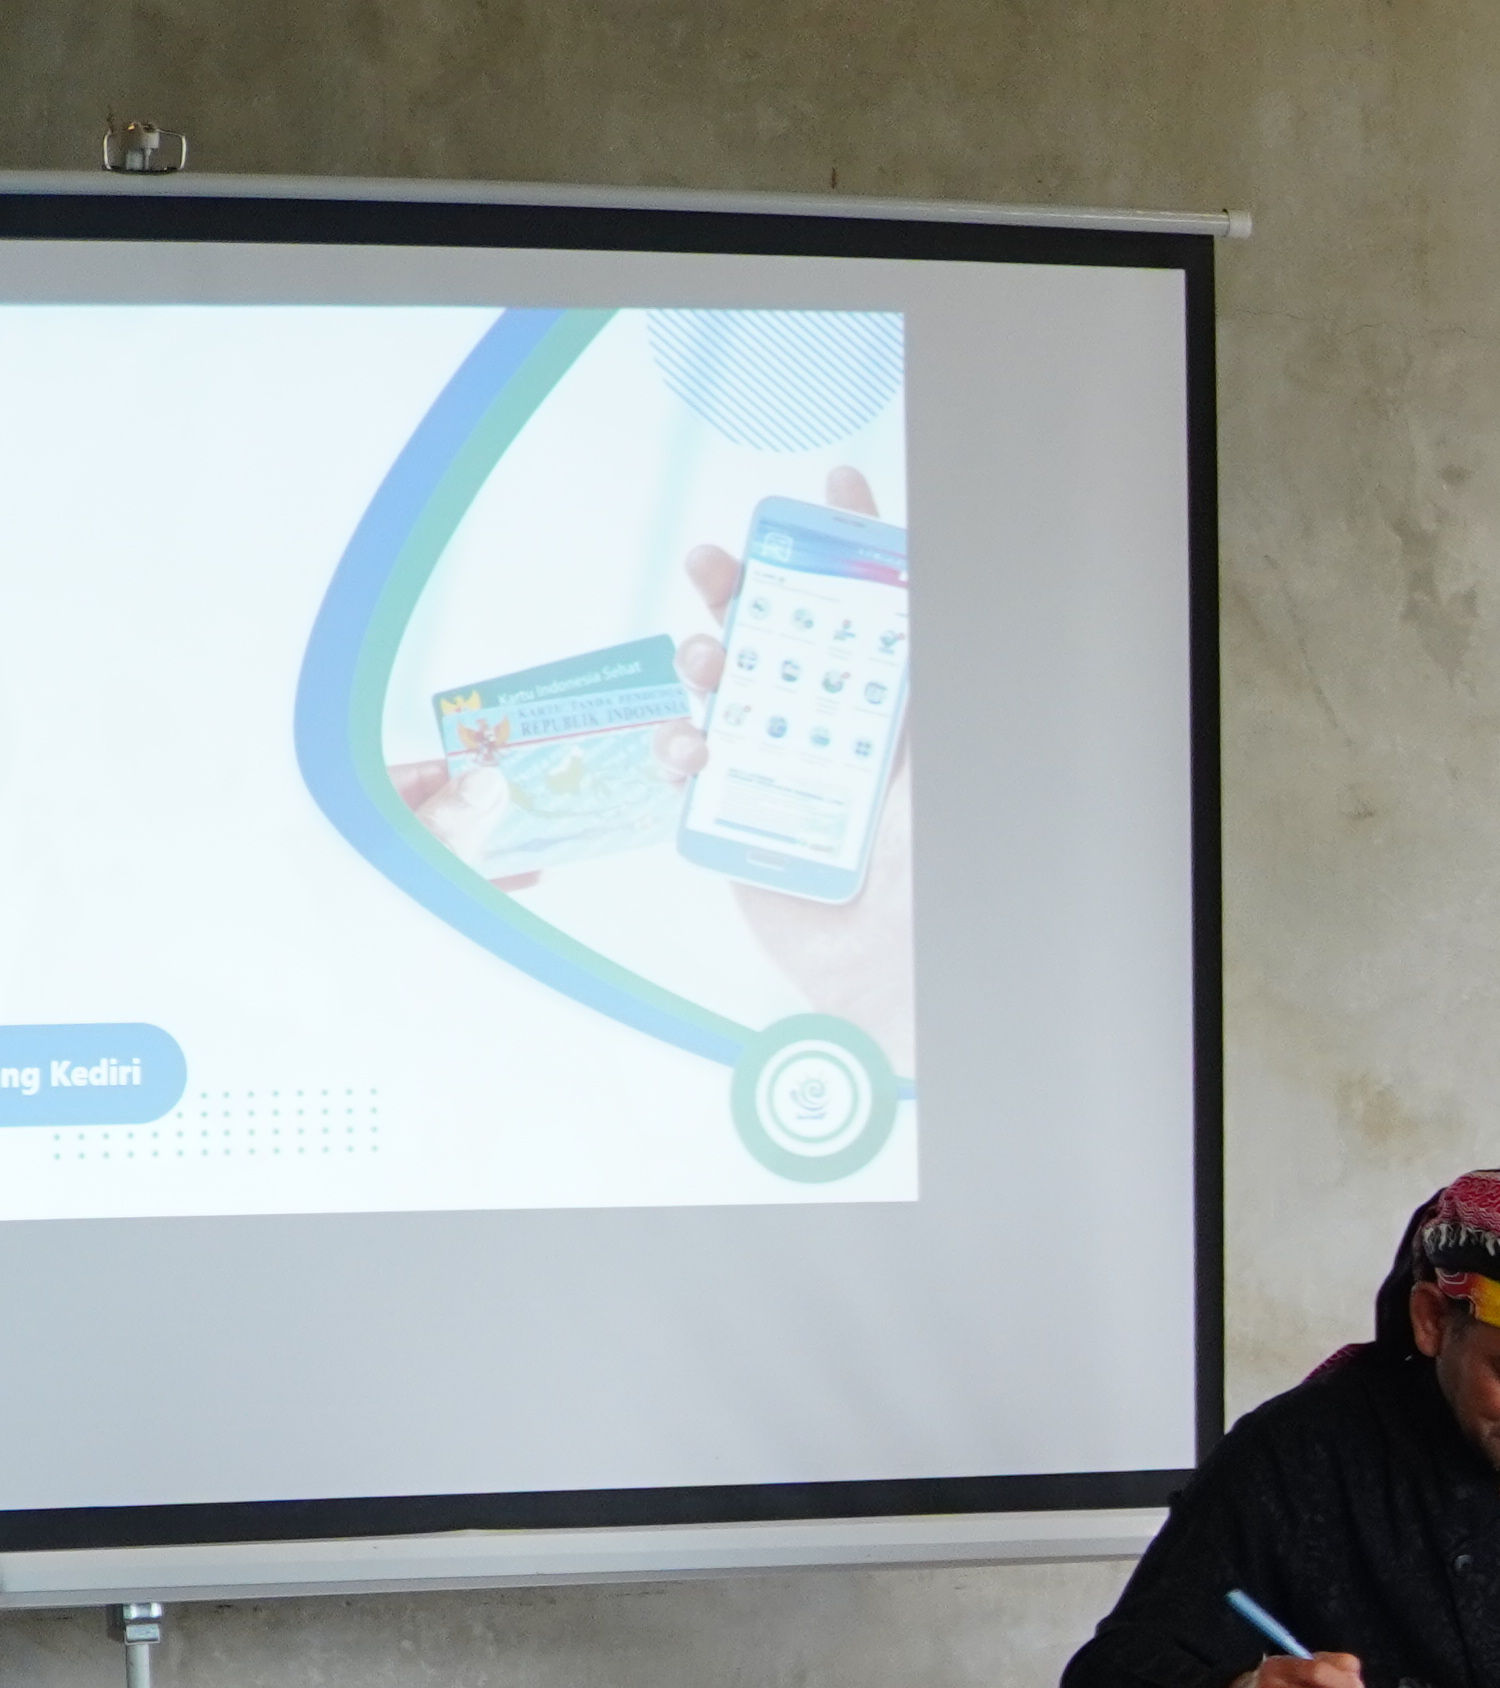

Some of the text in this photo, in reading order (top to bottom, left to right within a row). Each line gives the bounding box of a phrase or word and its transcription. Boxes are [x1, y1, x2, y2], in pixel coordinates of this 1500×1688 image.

[497, 661, 642, 706] Kartu Indonesia Sehat
[520, 701, 689, 737] REPUBLIK INDONESIA
[50, 1057, 142, 1087] Kediri
